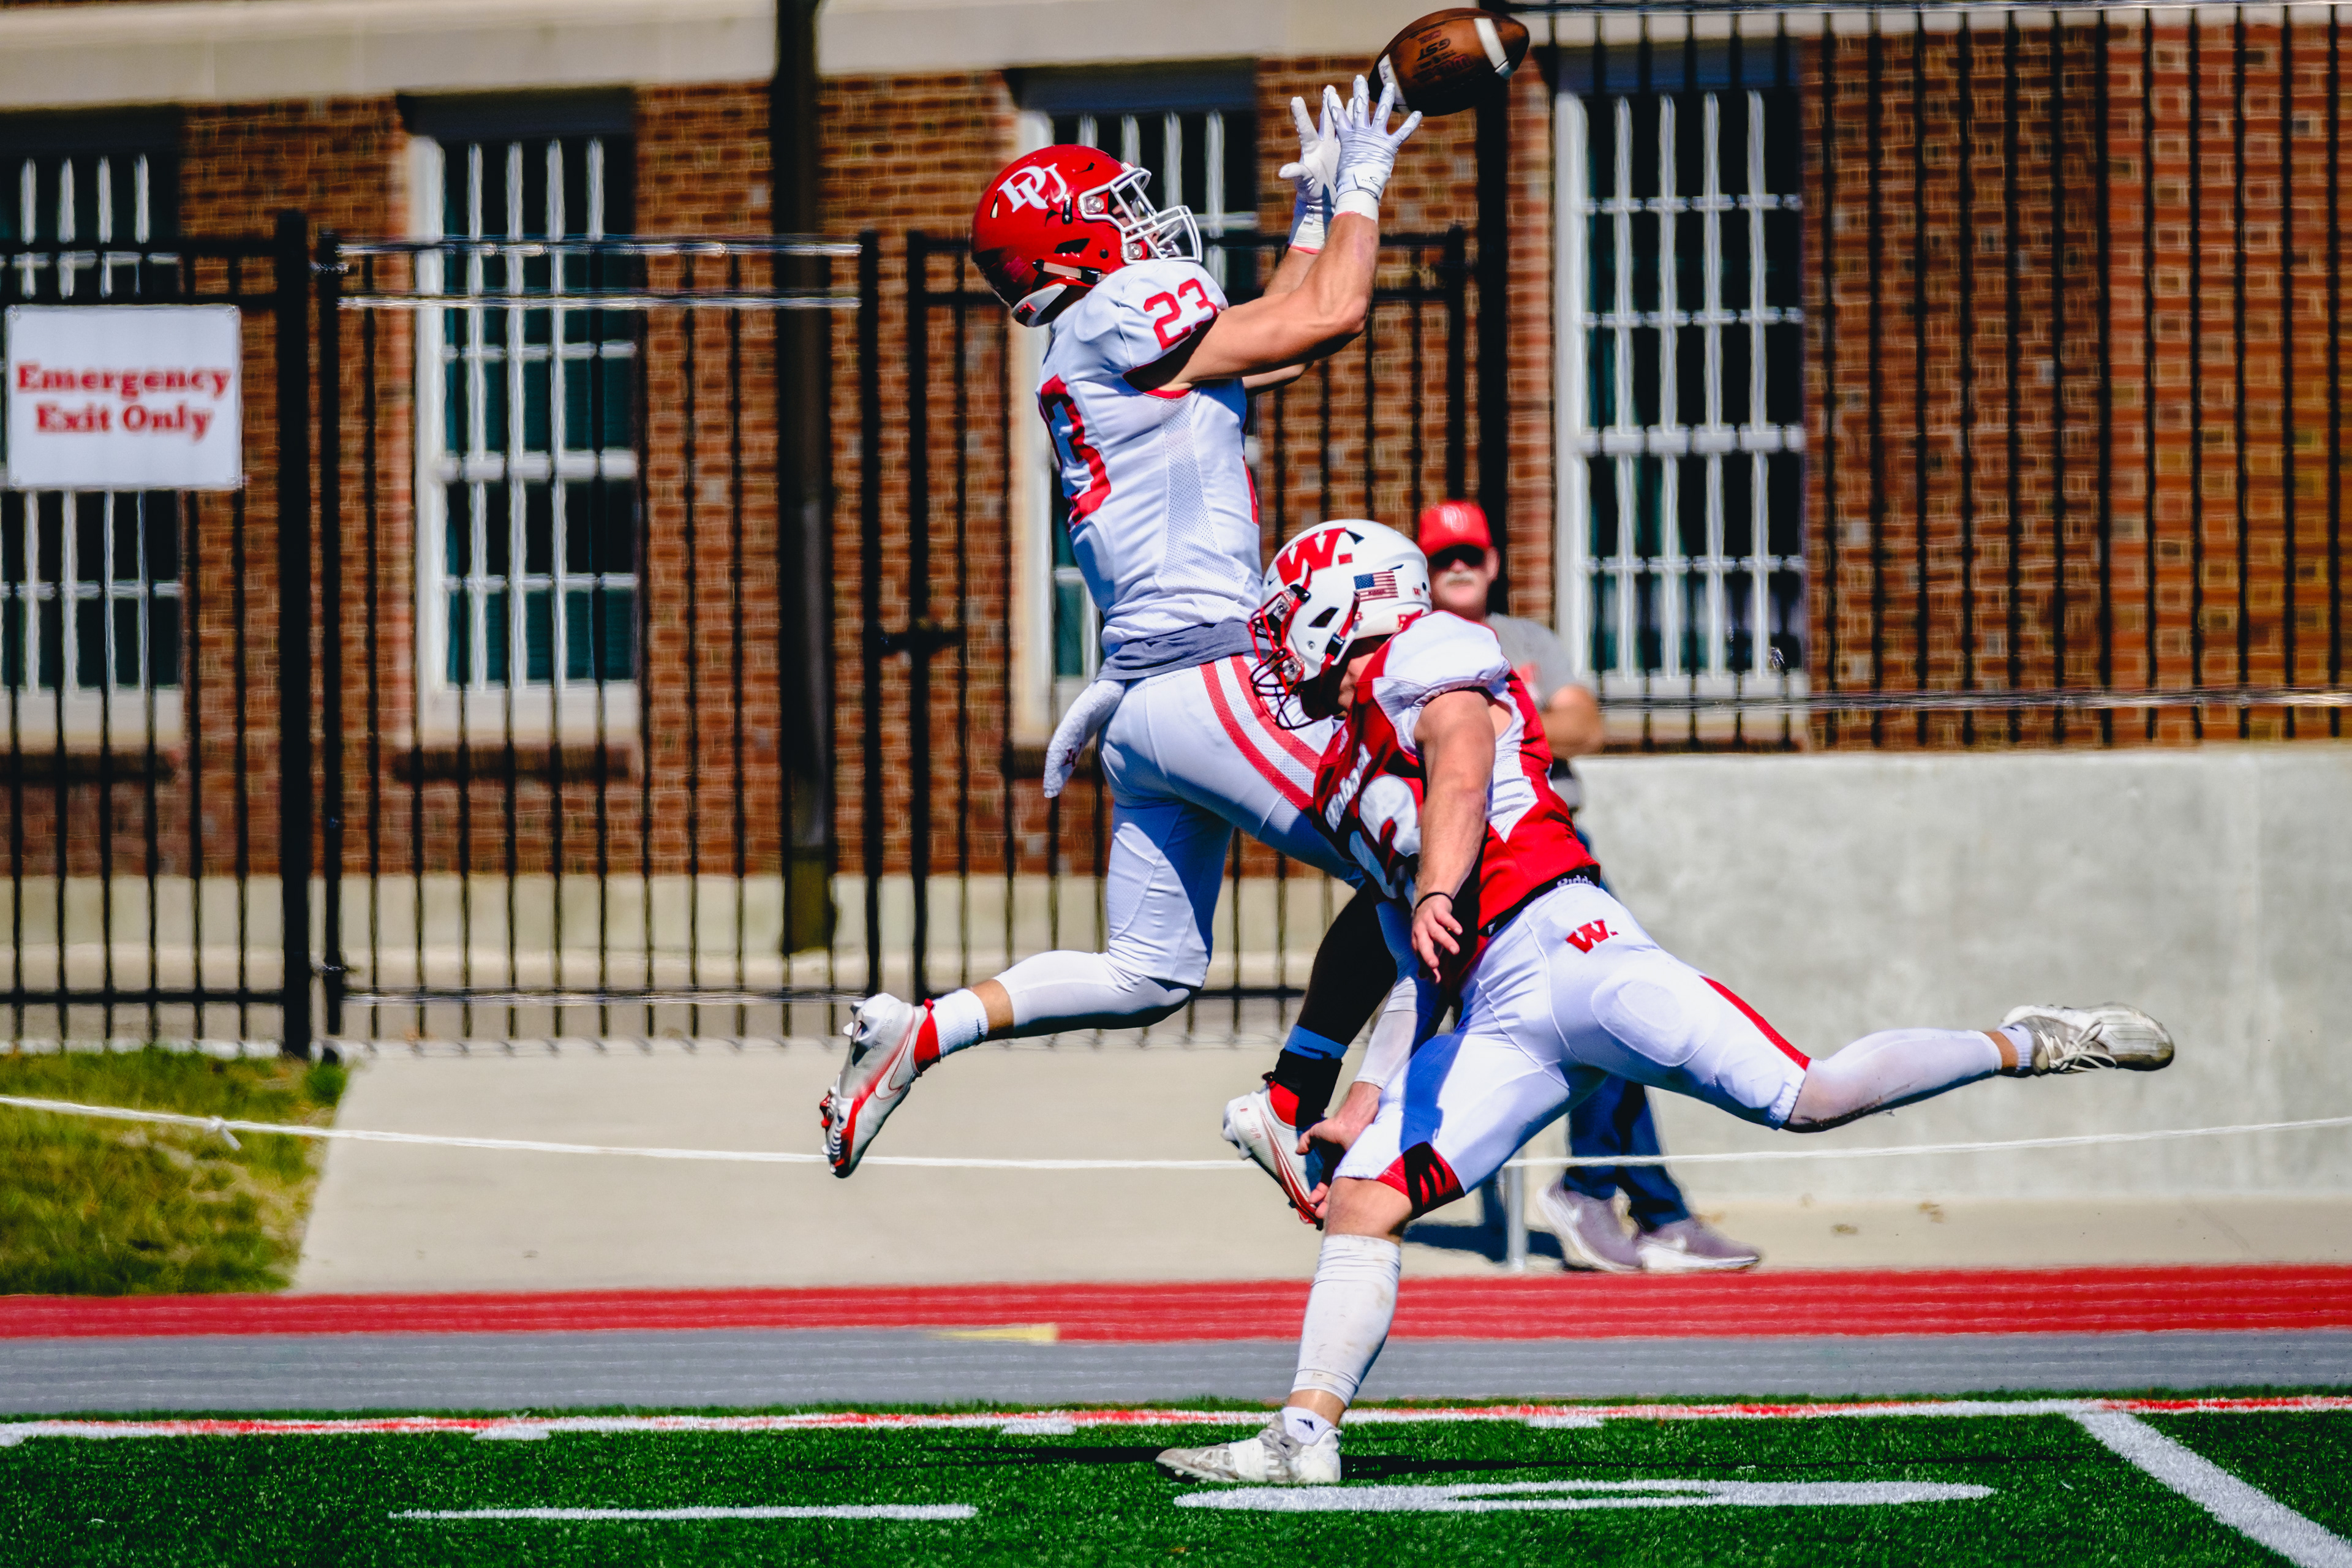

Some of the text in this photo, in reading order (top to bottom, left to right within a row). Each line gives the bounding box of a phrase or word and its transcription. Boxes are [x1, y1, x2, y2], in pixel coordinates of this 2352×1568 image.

[1144, 278, 1220, 351] 23
[17, 363, 232, 400] Emergency
[36, 401, 213, 443] Exit Only
